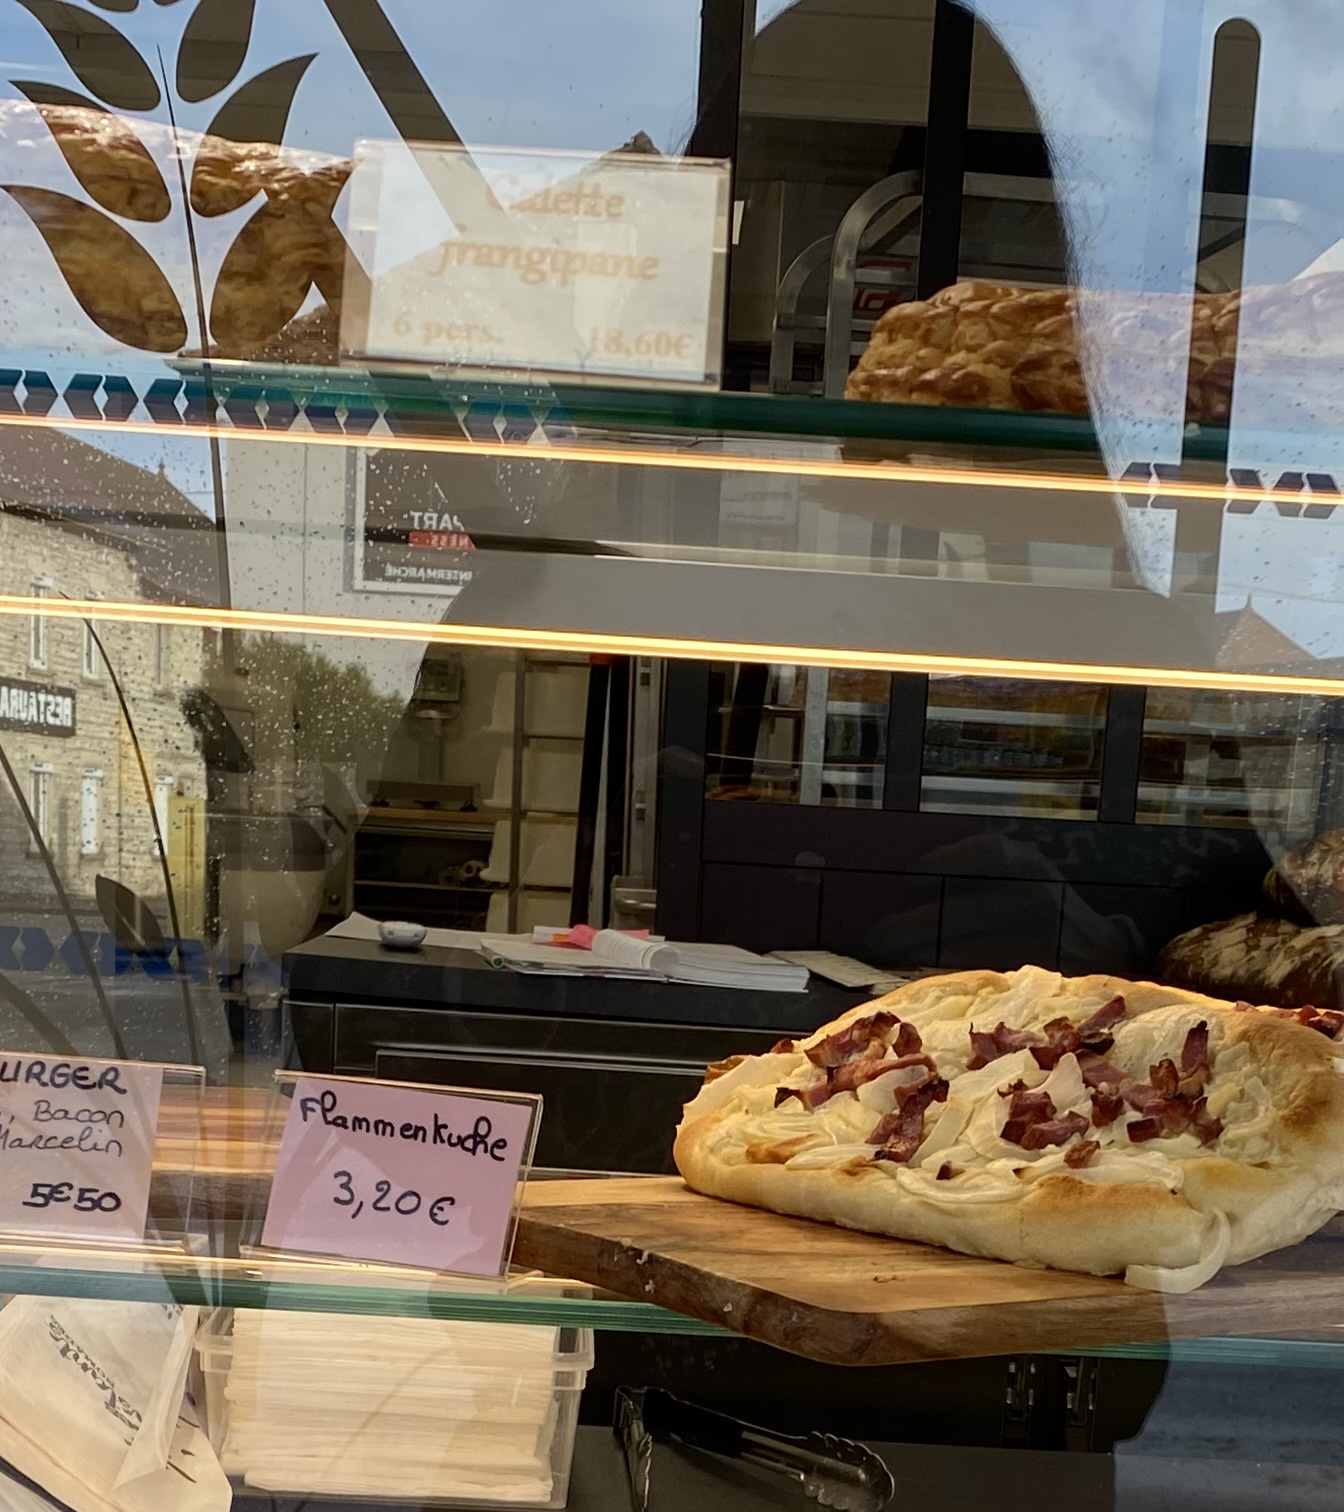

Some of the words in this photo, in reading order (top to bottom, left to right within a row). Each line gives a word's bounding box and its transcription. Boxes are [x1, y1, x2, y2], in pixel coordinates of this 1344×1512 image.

[428, 222, 660, 287] frangipane
[393, 311, 413, 338] 6
[421, 317, 503, 346] pers.
[33, 1099, 125, 1129] Bacon
